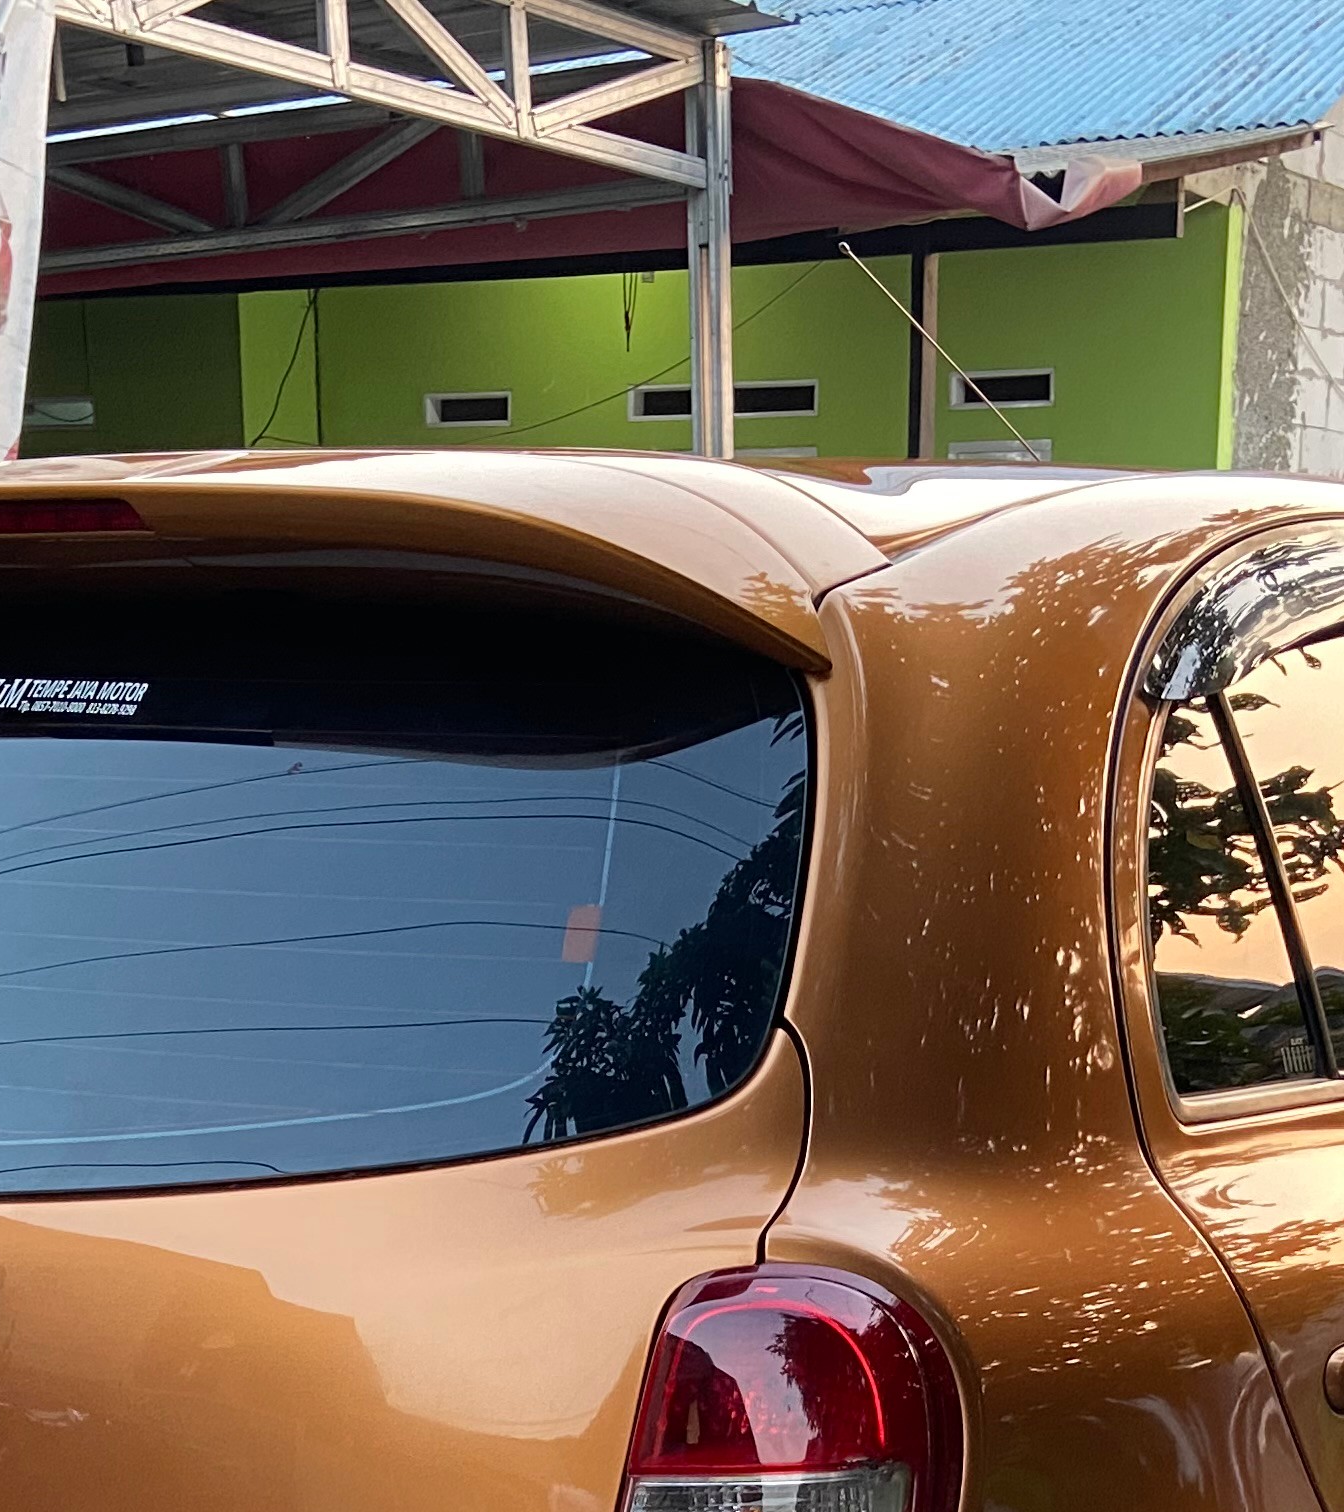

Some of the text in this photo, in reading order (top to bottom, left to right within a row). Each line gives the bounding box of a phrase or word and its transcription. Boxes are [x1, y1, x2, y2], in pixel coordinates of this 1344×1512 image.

[27, 679, 73, 699] TEMPE
[67, 680, 99, 700] JAYA
[96, 682, 149, 702] MOTOR
